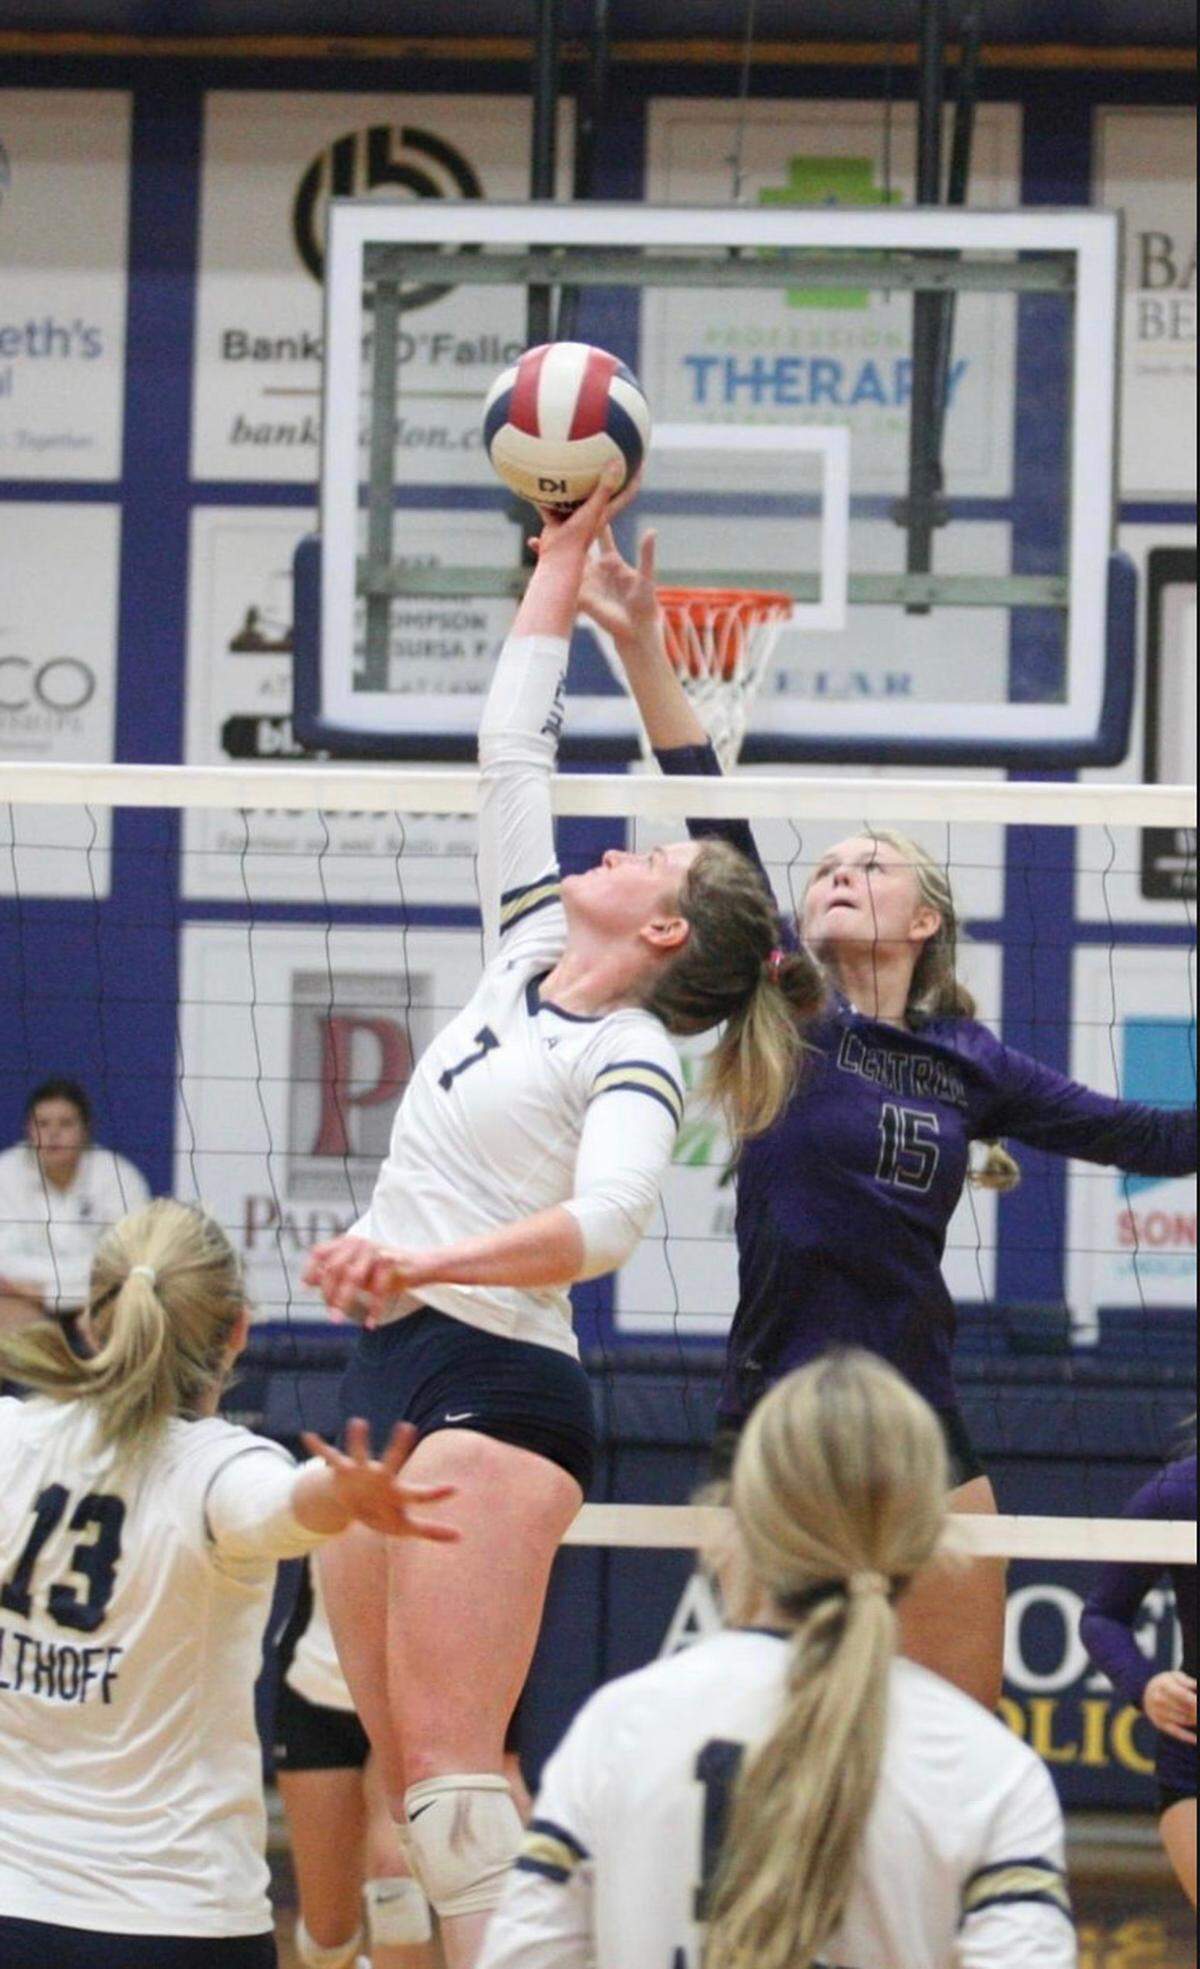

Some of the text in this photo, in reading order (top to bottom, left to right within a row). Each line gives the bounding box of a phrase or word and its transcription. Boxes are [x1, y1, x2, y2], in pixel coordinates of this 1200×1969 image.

[222, 329, 322, 361] Bank
[311, 1014, 416, 1158] P
[875, 1102, 941, 1194] 15
[0, 1483, 126, 1633] 13
